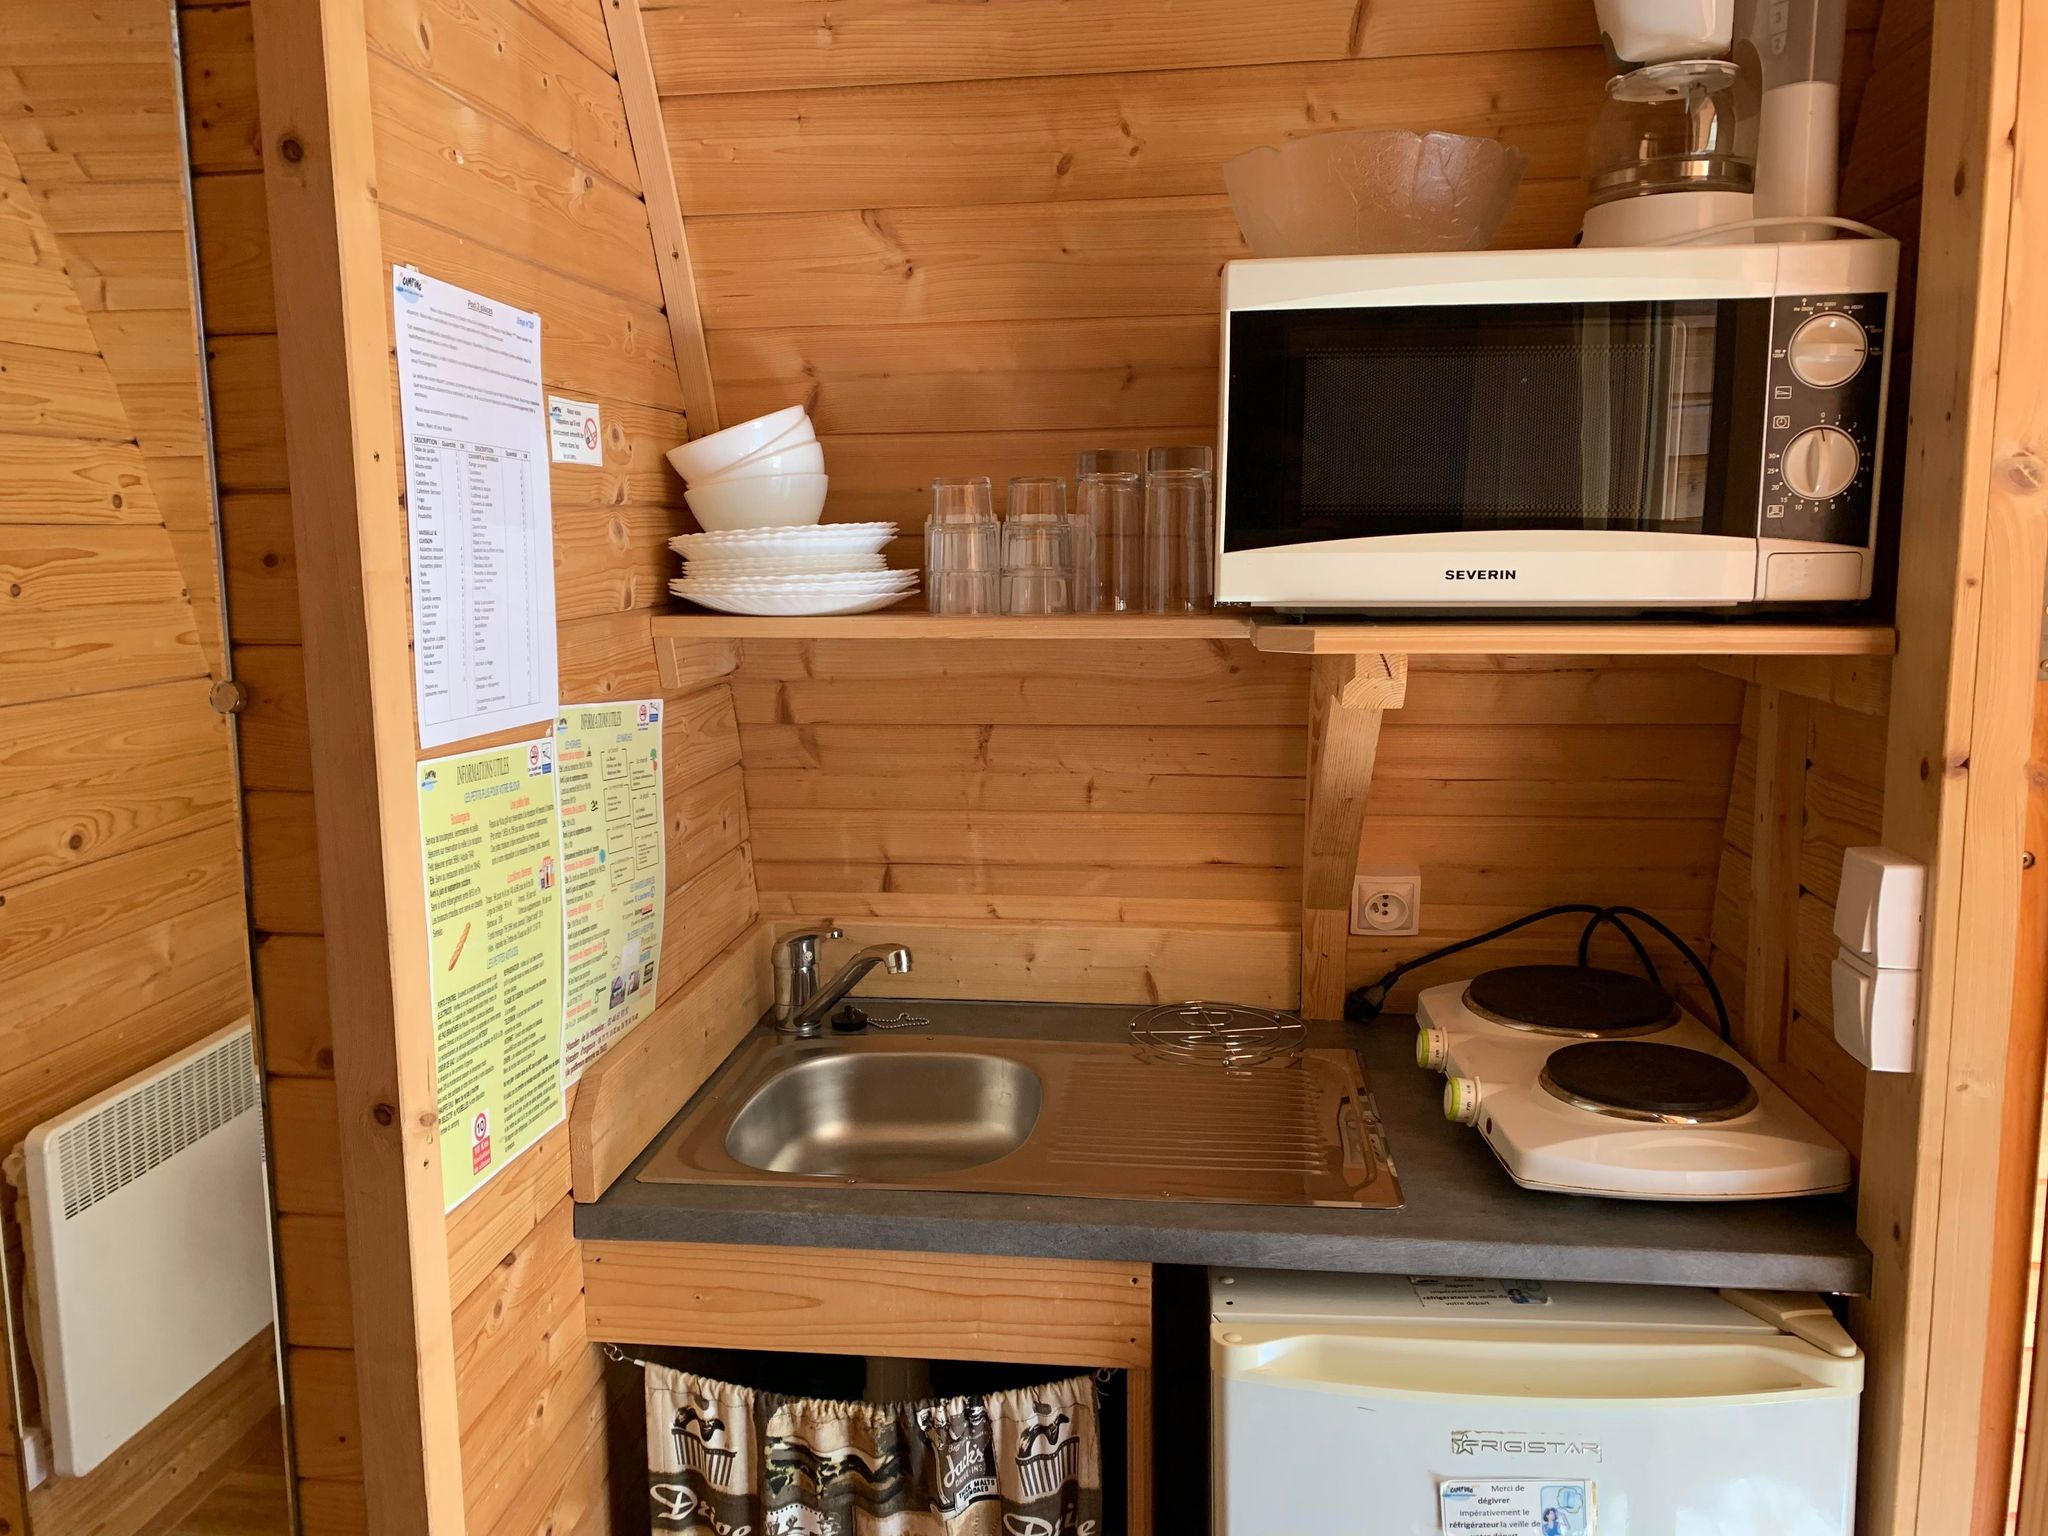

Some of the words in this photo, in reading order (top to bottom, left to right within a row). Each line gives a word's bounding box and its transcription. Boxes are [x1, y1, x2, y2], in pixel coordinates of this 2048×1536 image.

[1445, 570, 1516, 580] SEVERIN
[457, 759, 494, 785] INFORMATIONS
[494, 756, 510, 778] UTILES
[1463, 1439, 1600, 1455] FRIGISTAR
[944, 1441, 984, 1488] Jack's
[974, 1479, 995, 1487] MALTS
[1478, 1497, 1510, 1506] dégivrer
[1460, 1509, 1521, 1517] impérativement
[1449, 1521, 1499, 1530] réfrigérateur
[1531, 1520, 1541, 1528] de
